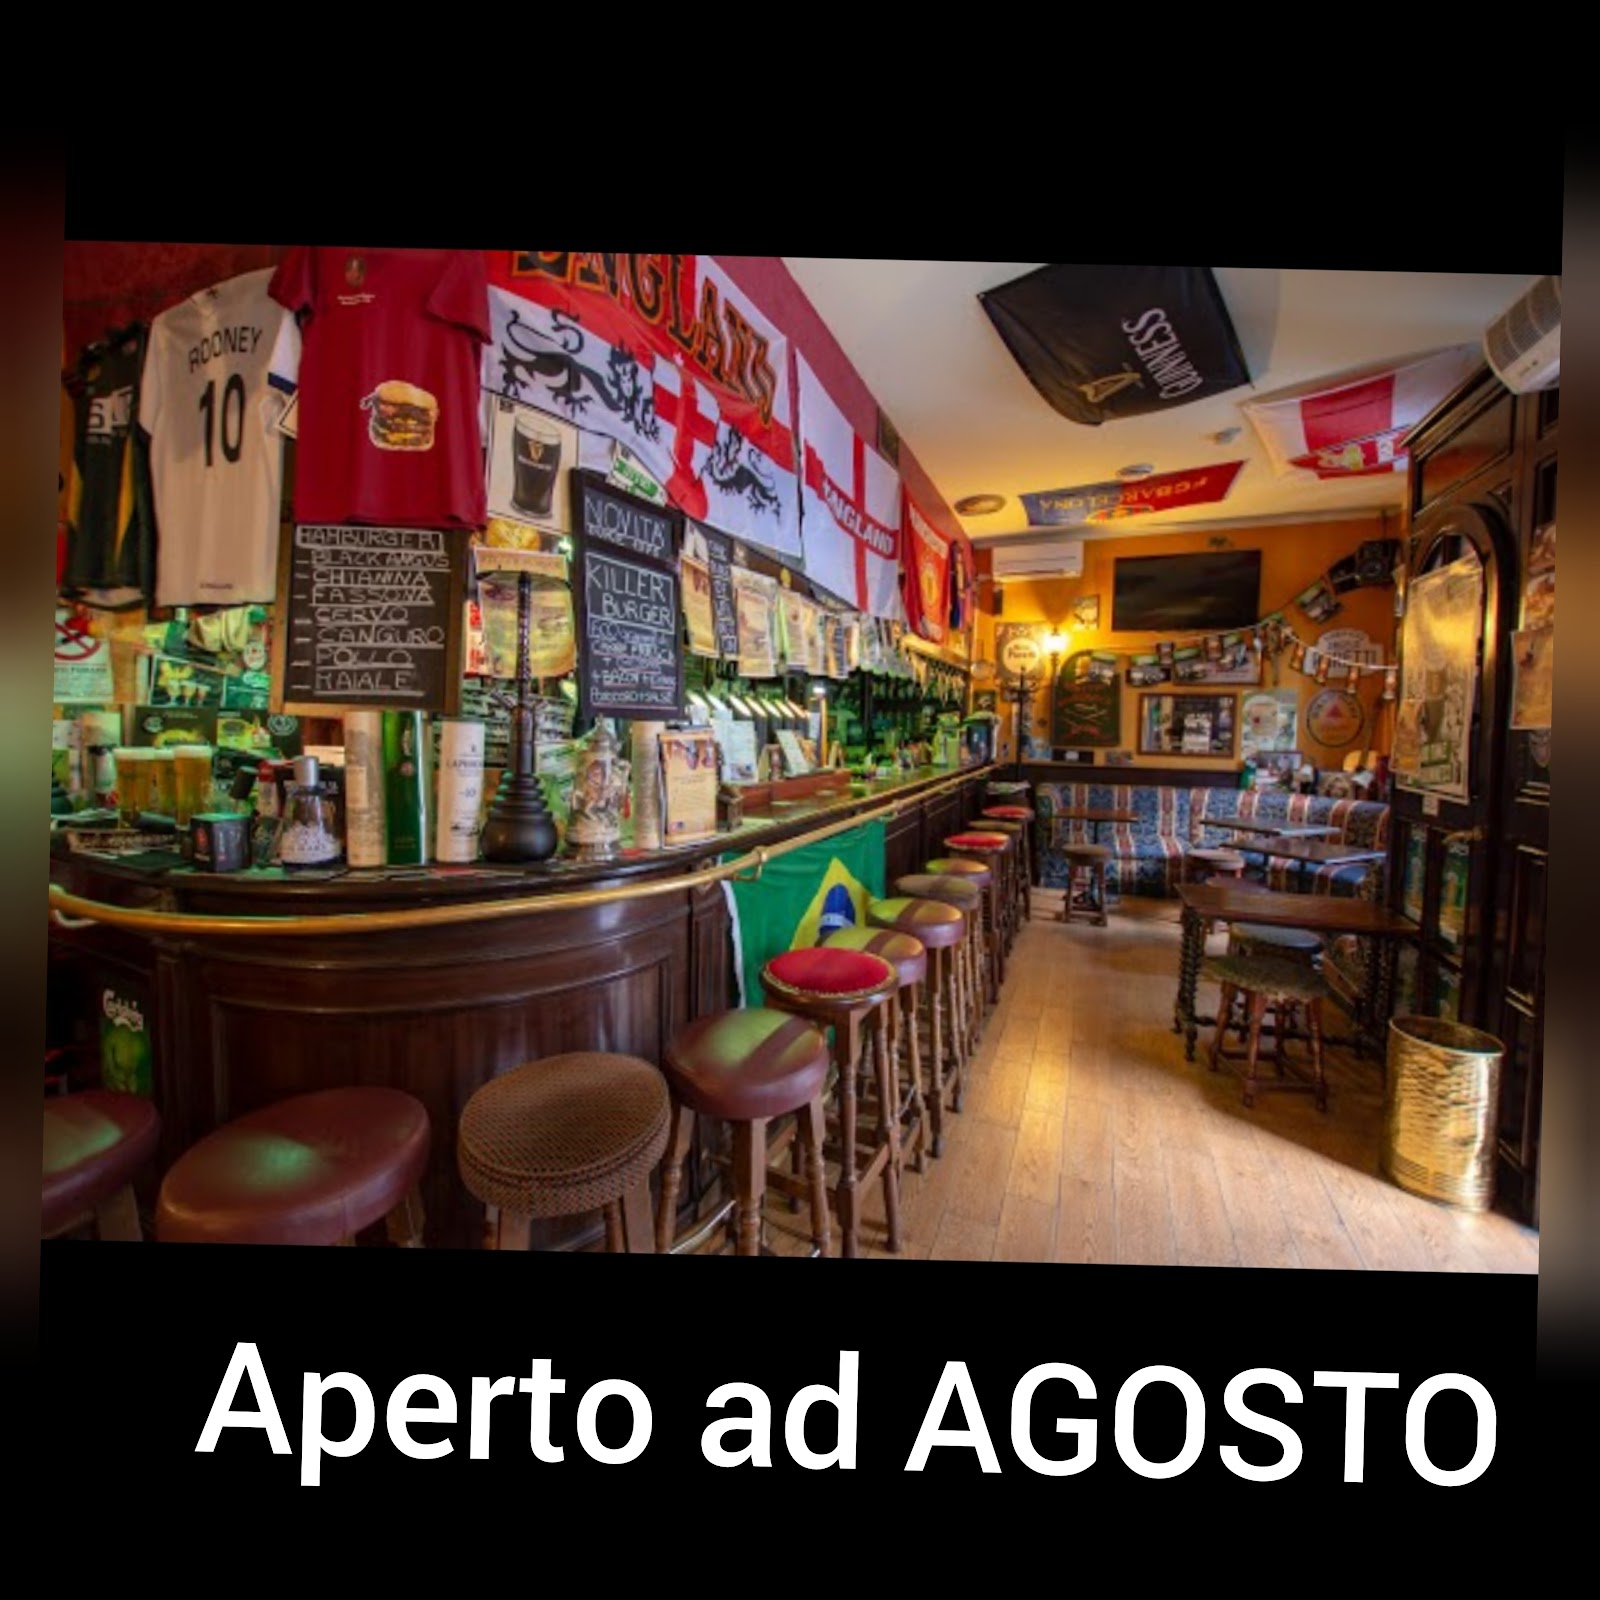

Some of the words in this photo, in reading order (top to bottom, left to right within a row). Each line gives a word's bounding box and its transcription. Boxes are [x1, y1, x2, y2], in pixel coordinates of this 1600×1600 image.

[187, 325, 263, 374] ROONEY
[1121, 308, 1204, 399] GUINNESS
[198, 373, 246, 467] 10
[585, 564, 667, 602] KILLER
[314, 606, 409, 623] CERVO
[602, 592, 672, 627] BURGER
[316, 625, 445, 645] CANGURO
[315, 647, 413, 665] POLLO
